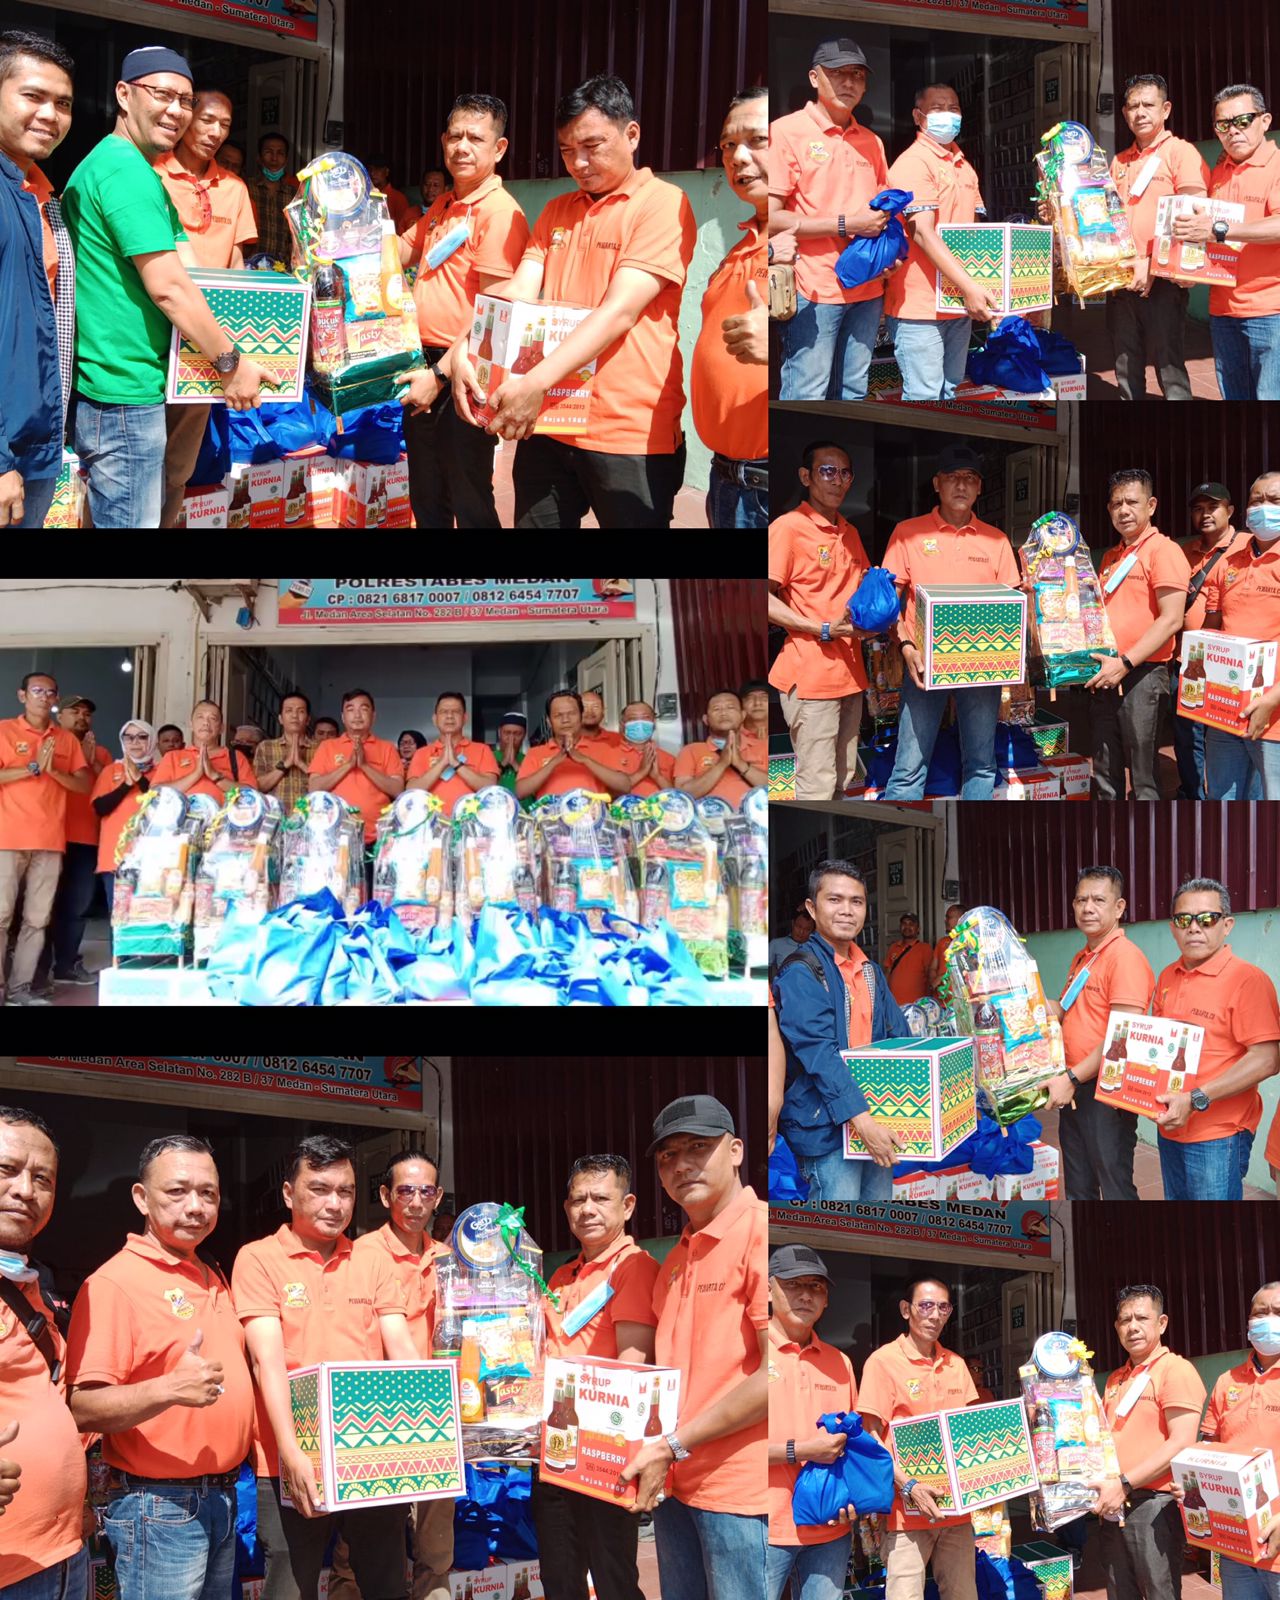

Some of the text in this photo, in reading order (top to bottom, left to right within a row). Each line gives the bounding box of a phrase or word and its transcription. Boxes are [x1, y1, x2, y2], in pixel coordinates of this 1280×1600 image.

[222, 4, 268, 23] Sumatera
[270, 15, 295, 30] Utara
[972, 0, 1000, 11] Medan
[1007, 6, 1045, 17] Sumatera
[1047, 10, 1068, 20] Utara
[547, 388, 590, 398] RASPBERRY
[1060, 384, 1085, 394] KURNIA
[945, 400, 973, 412] Medan
[980, 407, 1016, 419] Sumatera
[1017, 412, 1039, 422] Utara
[252, 469, 271, 479] SYRUP
[251, 475, 282, 488] KURNIA
[190, 505, 226, 519] KURNIA
[335, 578, 486, 588] POLRESTABES
[327, 594, 345, 604] CP
[357, 594, 387, 604] 0821
[393, 593, 423, 603] 6817
[429, 592, 460, 602] 0007
[472, 591, 505, 601] 0812
[509, 590, 541, 600] 6454
[547, 589, 579, 599] 7707
[315, 610, 347, 618] Medan
[350, 609, 373, 618] Area
[375, 608, 412, 617] Selatan
[415, 608, 430, 617] No.
[434, 608, 451, 616] 282
[454, 608, 462, 616] B
[471, 608, 482, 616] 37
[486, 607, 518, 615] Medan
[528, 606, 577, 615] Sumatera
[580, 605, 608, 614] Utara
[1207, 643, 1230, 654] SYRUP
[1206, 653, 1243, 669] KURNIA
[1207, 692, 1240, 707] RASPBERRY
[1066, 774, 1089, 783] KURNIA
[1033, 791, 1058, 800] KURNIA
[1131, 1021, 1153, 1031] SYRUP
[1130, 1031, 1164, 1046] KURNIA
[263, 1057, 298, 1071] 0812
[302, 1063, 336, 1076] 6454
[339, 1066, 372, 1081] 7707
[115, 1058, 144, 1069] Area
[149, 1061, 193, 1076] Selatan
[197, 1067, 216, 1079] No.
[220, 1070, 240, 1082] 282
[243, 1073, 252, 1083] B
[261, 1074, 273, 1085] 37
[276, 1077, 312, 1091] Medan
[321, 1083, 368, 1098] Sumatera
[372, 1090, 397, 1101] Utara
[1126, 1074, 1157, 1087] RASPBERRY
[959, 1180, 983, 1191] KURNIA
[1022, 1180, 1045, 1190] KURNIA
[909, 1189, 935, 1199] KURNIA
[821, 1200, 851, 1213] 0821
[856, 1205, 886, 1217] 6817
[890, 1209, 918, 1222] 0007
[928, 1215, 955, 1227] 0812
[959, 1219, 984, 1231] 6454
[987, 1223, 1012, 1234] 7707
[946, 1202, 1006, 1219] MEDAN
[777, 1211, 810, 1222] Medan
[813, 1215, 837, 1225] Area
[840, 1219, 875, 1231] Selatan
[877, 1223, 892, 1232] No.
[895, 1226, 911, 1235] 282
[913, 1228, 920, 1236] B
[927, 1229, 937, 1237] 37
[940, 1231, 966, 1242] Medan
[974, 1236, 1010, 1247] Sumatera
[1012, 1240, 1032, 1250] Utara
[579, 1373, 611, 1388] SYRUP
[491, 1381, 521, 1405] Tasty
[579, 1388, 630, 1409] KURNIA
[581, 1446, 626, 1465] RASPBERRY
[596, 1465, 620, 1477] 3544.201
[1199, 1471, 1223, 1481] SYRUP
[1200, 1481, 1241, 1497] KURNIA
[1212, 1521, 1248, 1537] RASPBERRY
[473, 1581, 505, 1595] KURNIA
